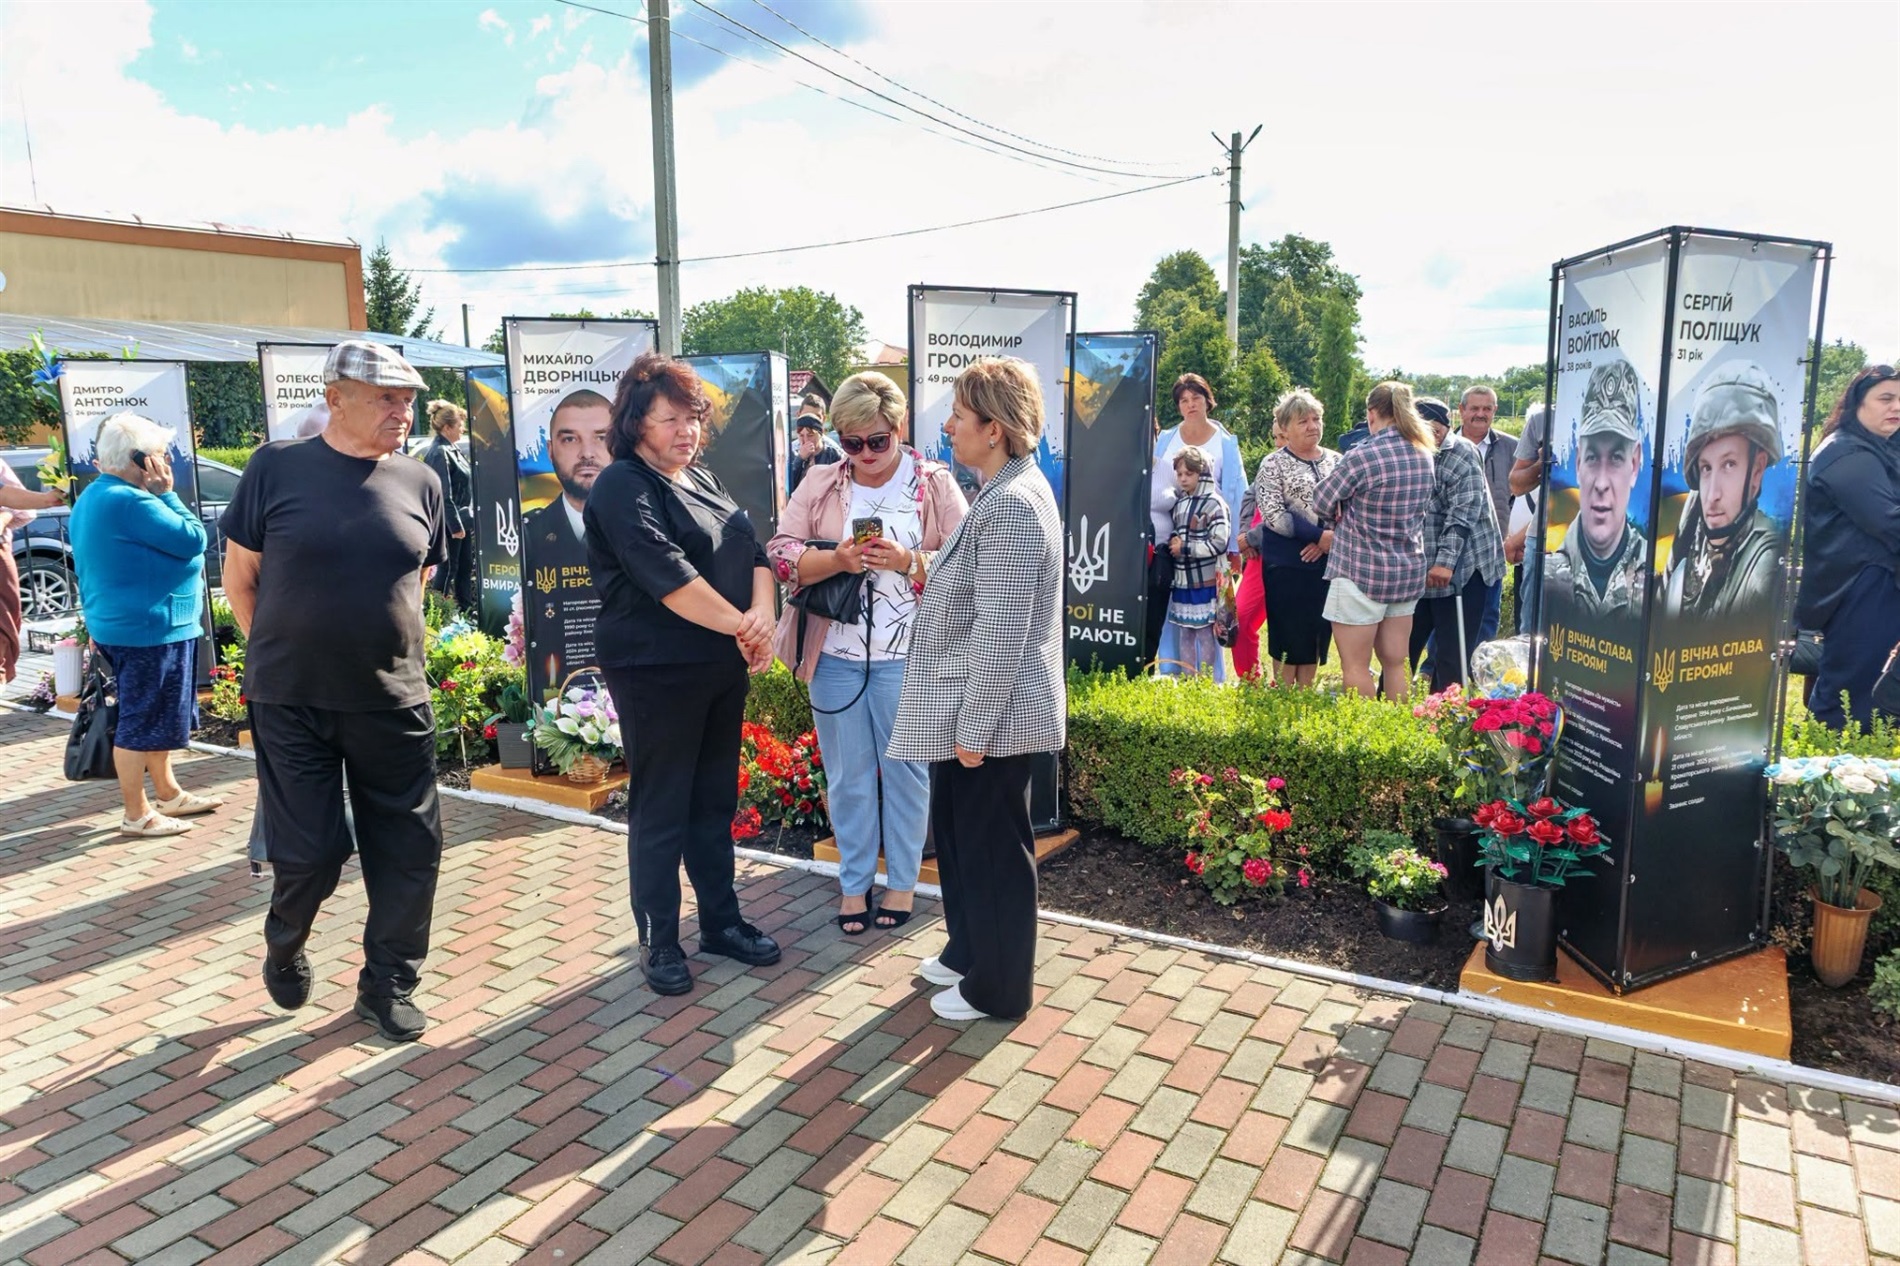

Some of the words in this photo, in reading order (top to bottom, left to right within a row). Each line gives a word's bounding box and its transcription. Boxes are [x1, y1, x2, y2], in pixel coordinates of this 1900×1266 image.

[1683, 292, 1733, 312] СЕРГІЙ
[1568, 308, 1607, 329] ВАСИЛЬ
[1680, 320, 1762, 345] ПОЛІЩУК
[928, 333, 1023, 349] ВОЛОДИМИР
[1568, 329, 1620, 355] ВОЙТЮК
[523, 352, 594, 365] МИХАЙЛО
[1677, 349, 1687, 360] 31
[1688, 349, 1703, 362] рік
[1566, 361, 1575, 372] 38
[1575, 359, 1592, 371] років
[276, 374, 323, 383] ОЛЕКСІ
[523, 370, 628, 384] ДВОРНІЦЬК
[928, 374, 940, 383] 49
[73, 386, 124, 395] ДМИТРО
[74, 397, 148, 407] АНТОНЮК
[290, 401, 313, 409] років
[561, 566, 590, 576] ВІЧН
[483, 578, 521, 591] ВМИРА
[562, 577, 593, 588] ГЕРО
[1099, 607, 1124, 624] НЕ
[1070, 625, 1137, 647] РАЮТЬ
[1567, 630, 1597, 651] ВІЧНА
[1598, 640, 1633, 664] СЛАВА
[1681, 645, 1719, 663] ВІЧНА
[1723, 638, 1764, 657] СЛАВА
[1566, 647, 1607, 673] ГЕРОЯМ!
[1679, 661, 1733, 683] ГЕРОЯМ!
